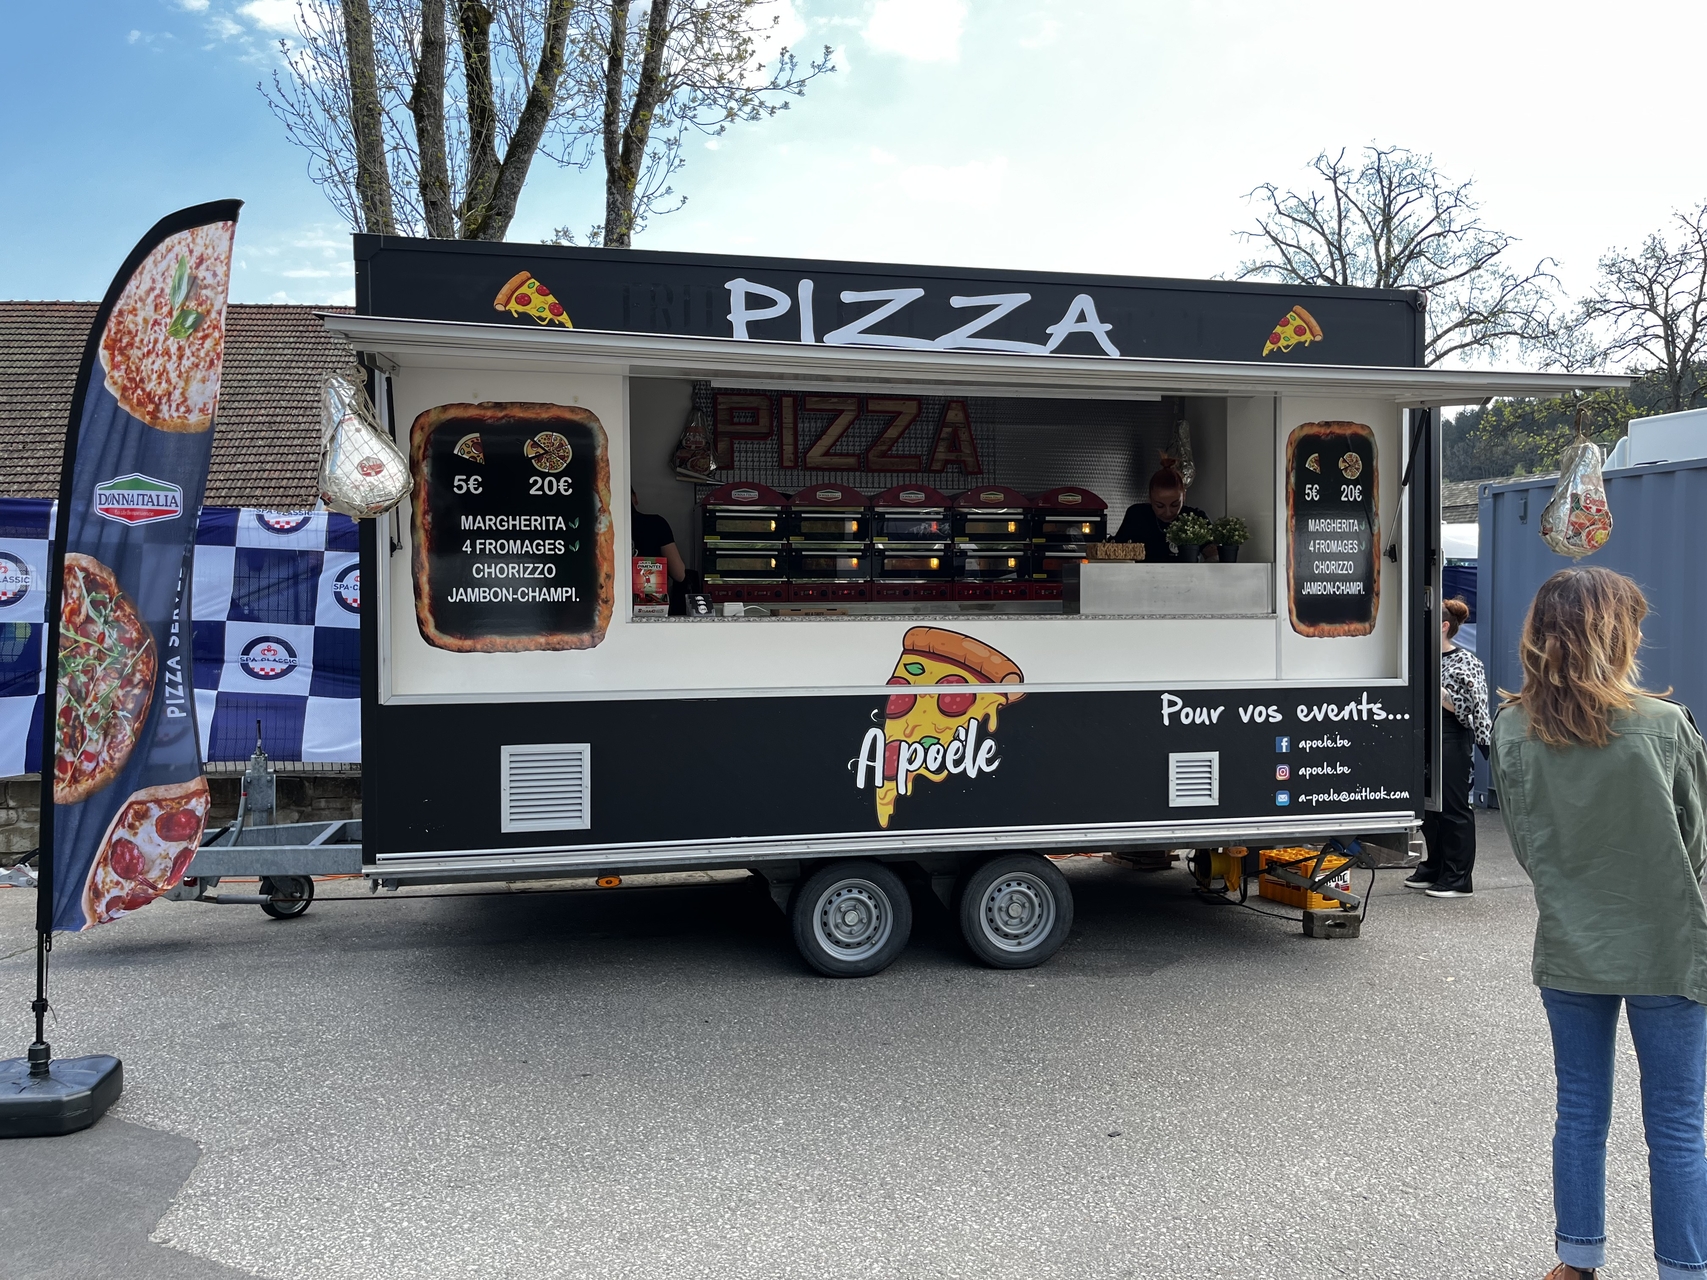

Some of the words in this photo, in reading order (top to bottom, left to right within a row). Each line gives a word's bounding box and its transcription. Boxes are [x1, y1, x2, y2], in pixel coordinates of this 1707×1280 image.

[724, 277, 1120, 358] PIZZA
[715, 393, 983, 475] PIZZA
[452, 475, 483, 495] 5€
[528, 476, 573, 496] 20€
[1304, 484, 1320, 501] 5€
[1340, 485, 1363, 502] 20€
[460, 515, 566, 531] MARGHERITA
[1308, 519, 1359, 532] MARGHERITA
[462, 539, 472, 555] 4
[476, 539, 565, 555] FROMAGES
[1308, 540, 1315, 552] 4
[1315, 540, 1359, 553] FROMAGES
[472, 563, 556, 579] CHORIZZO
[1313, 560, 1354, 574] CHORIZZO
[0, 576, 30, 584] ASSIC
[1301, 581, 1366, 595] JAMBON-CHAMPI.
[447, 586, 580, 603] JAMBON-CHAMPI.
[165, 655, 187, 718] PIZZA
[1160, 692, 1225, 726] Pour
[1238, 703, 1283, 724] vos
[1298, 734, 1351, 752] apoele.be
[1298, 761, 1352, 780] apoele.be
[1298, 786, 1410, 807] a-poele@outlook.com
